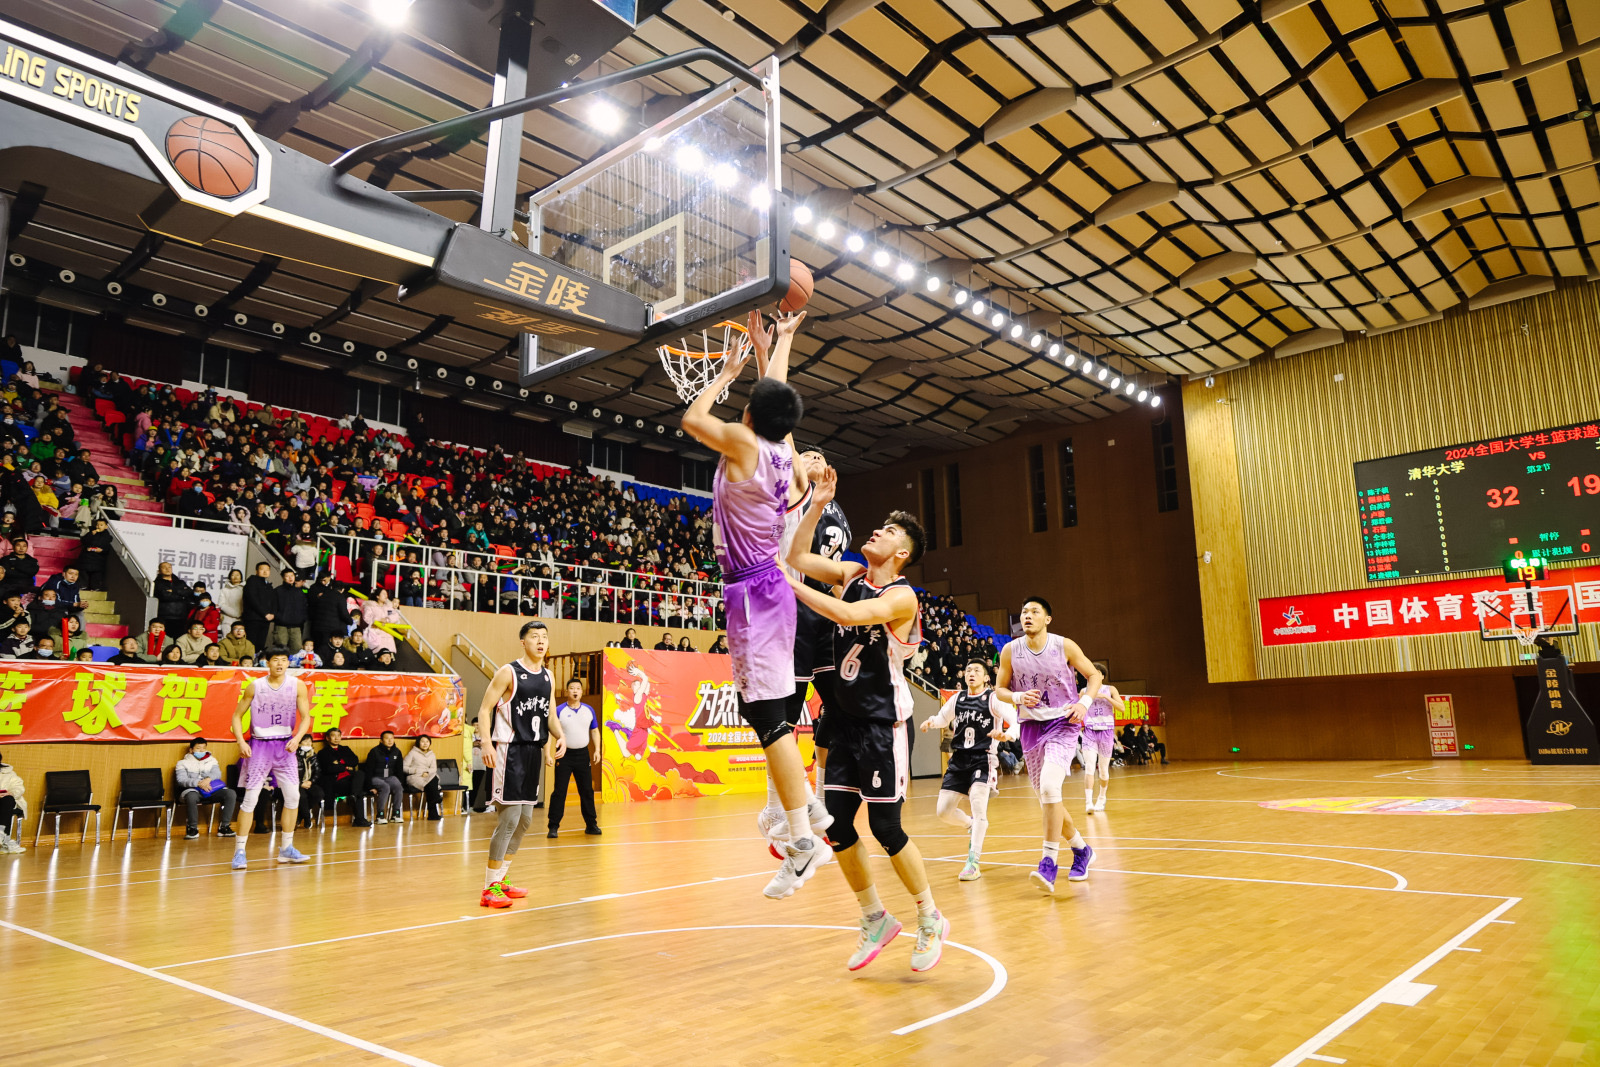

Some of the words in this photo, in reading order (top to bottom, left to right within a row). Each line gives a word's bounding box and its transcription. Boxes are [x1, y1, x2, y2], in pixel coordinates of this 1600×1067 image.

[0, 46, 47, 88] ING
[53, 66, 141, 122] SPORTS
[483, 261, 606, 324] 金陵
[1445, 424, 1600, 461] 2024全国大学生篮球邀
[1528, 451, 1546, 461] VS
[1408, 460, 1465, 480] 清华大学
[1526, 463, 1551, 474] 第2节
[1486, 486, 1520, 508] 32
[1567, 474, 1600, 497] 19
[1581, 543, 1591, 553] 0
[158, 549, 237, 571] 运动健康
[1517, 566, 1536, 580] 19
[1333, 586, 1543, 629] 中国体育彩票
[840, 643, 864, 681] 6
[1545, 668, 1562, 709] 金陵体育
[688, 682, 750, 726] 为热
[1094, 708, 1104, 716] 22
[271, 714, 282, 725] 12
[531, 715, 541, 741] 9
[964, 727, 975, 749] 8
[872, 771, 882, 788] 6
